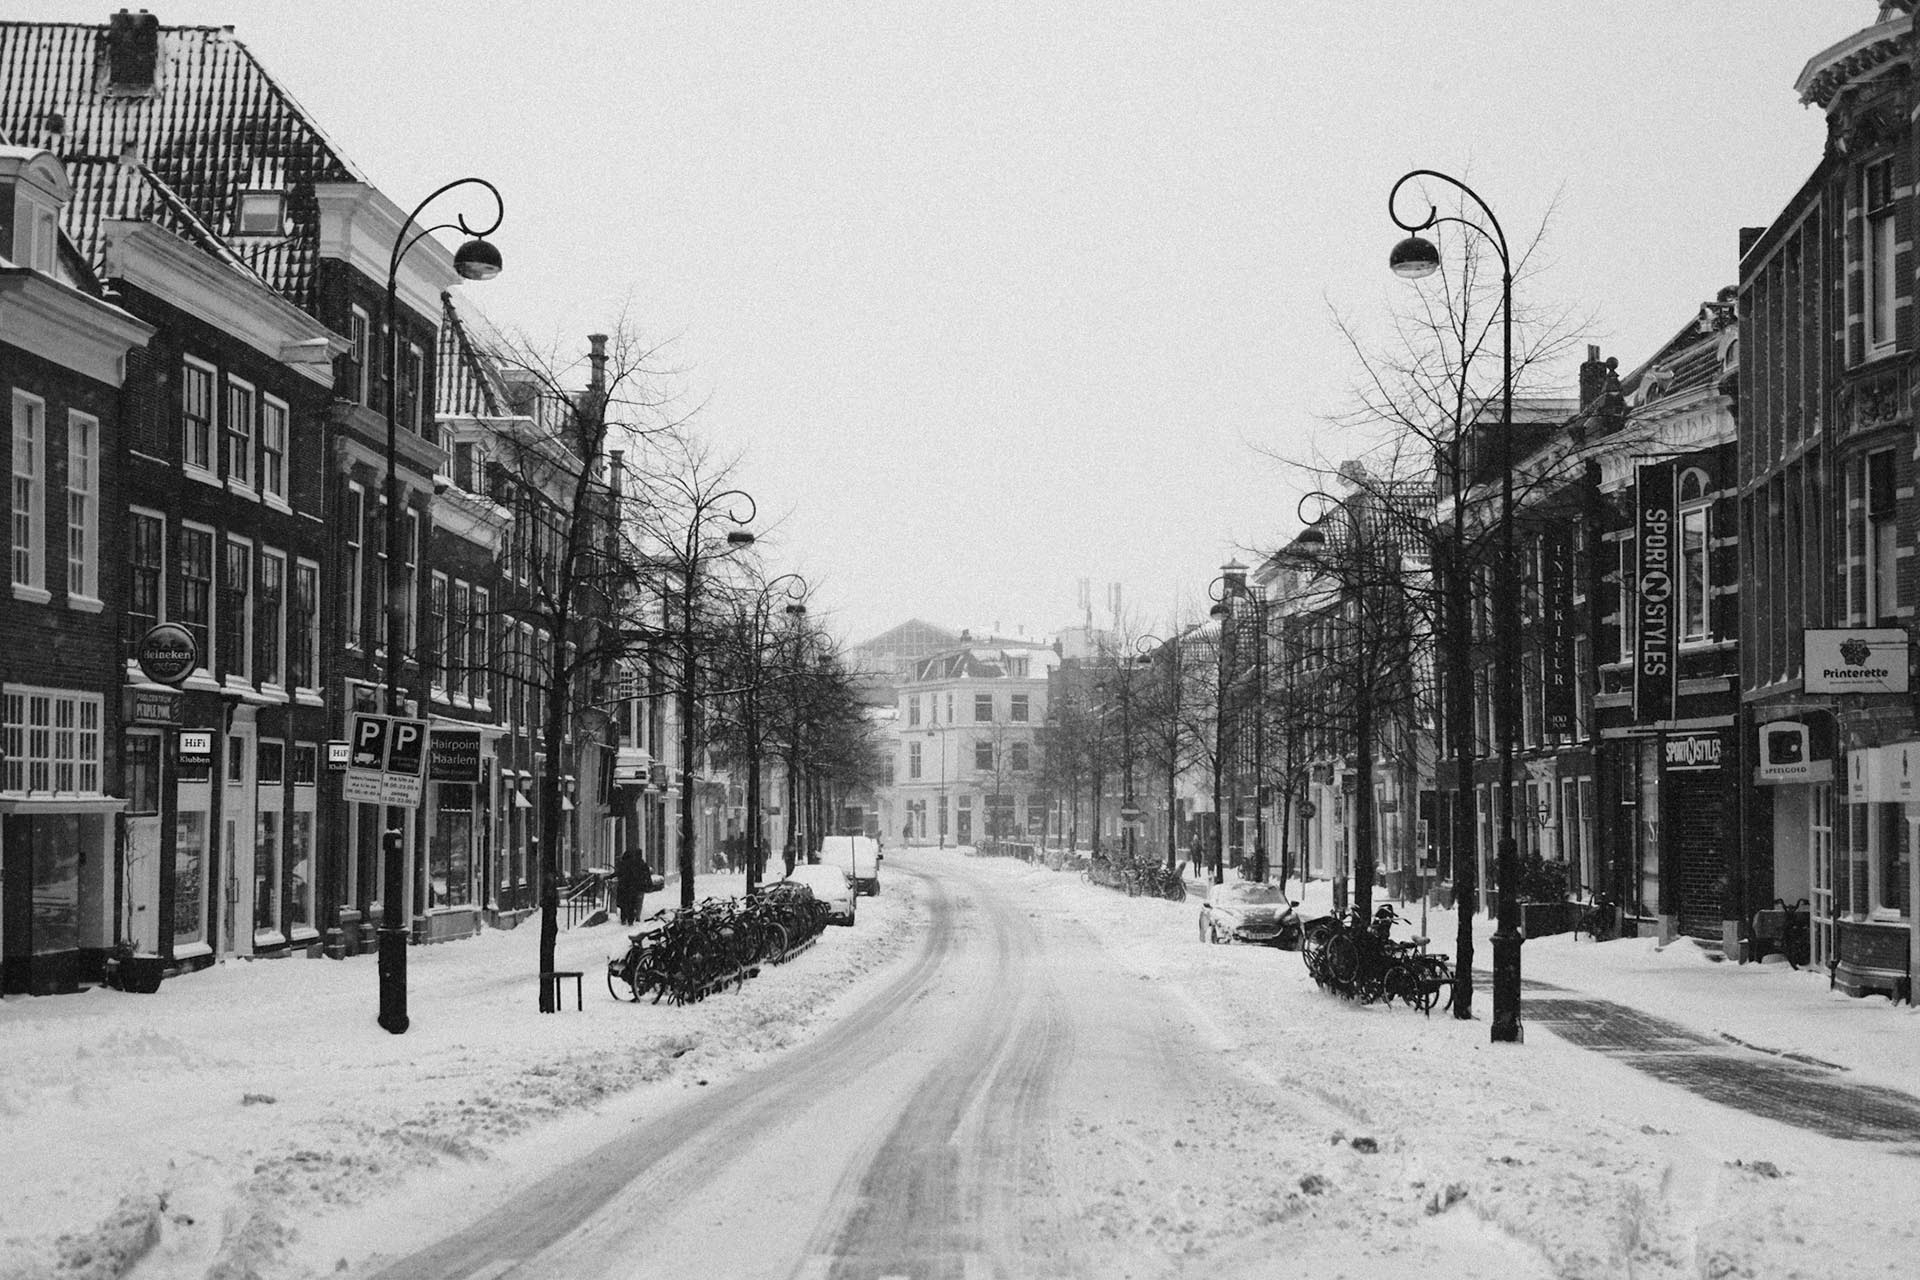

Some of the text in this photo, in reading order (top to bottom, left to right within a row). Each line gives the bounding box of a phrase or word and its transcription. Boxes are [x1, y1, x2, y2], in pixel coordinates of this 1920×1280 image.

[143, 650, 192, 660] Heineken
[1823, 668, 1889, 678] Printerette
[360, 721, 380, 746] P
[397, 725, 417, 751] P
[185, 738, 206, 747] HiFi
[431, 738, 479, 751] Hairpoint
[179, 755, 210, 764] Klubben
[432, 752, 477, 765] Haarlem
